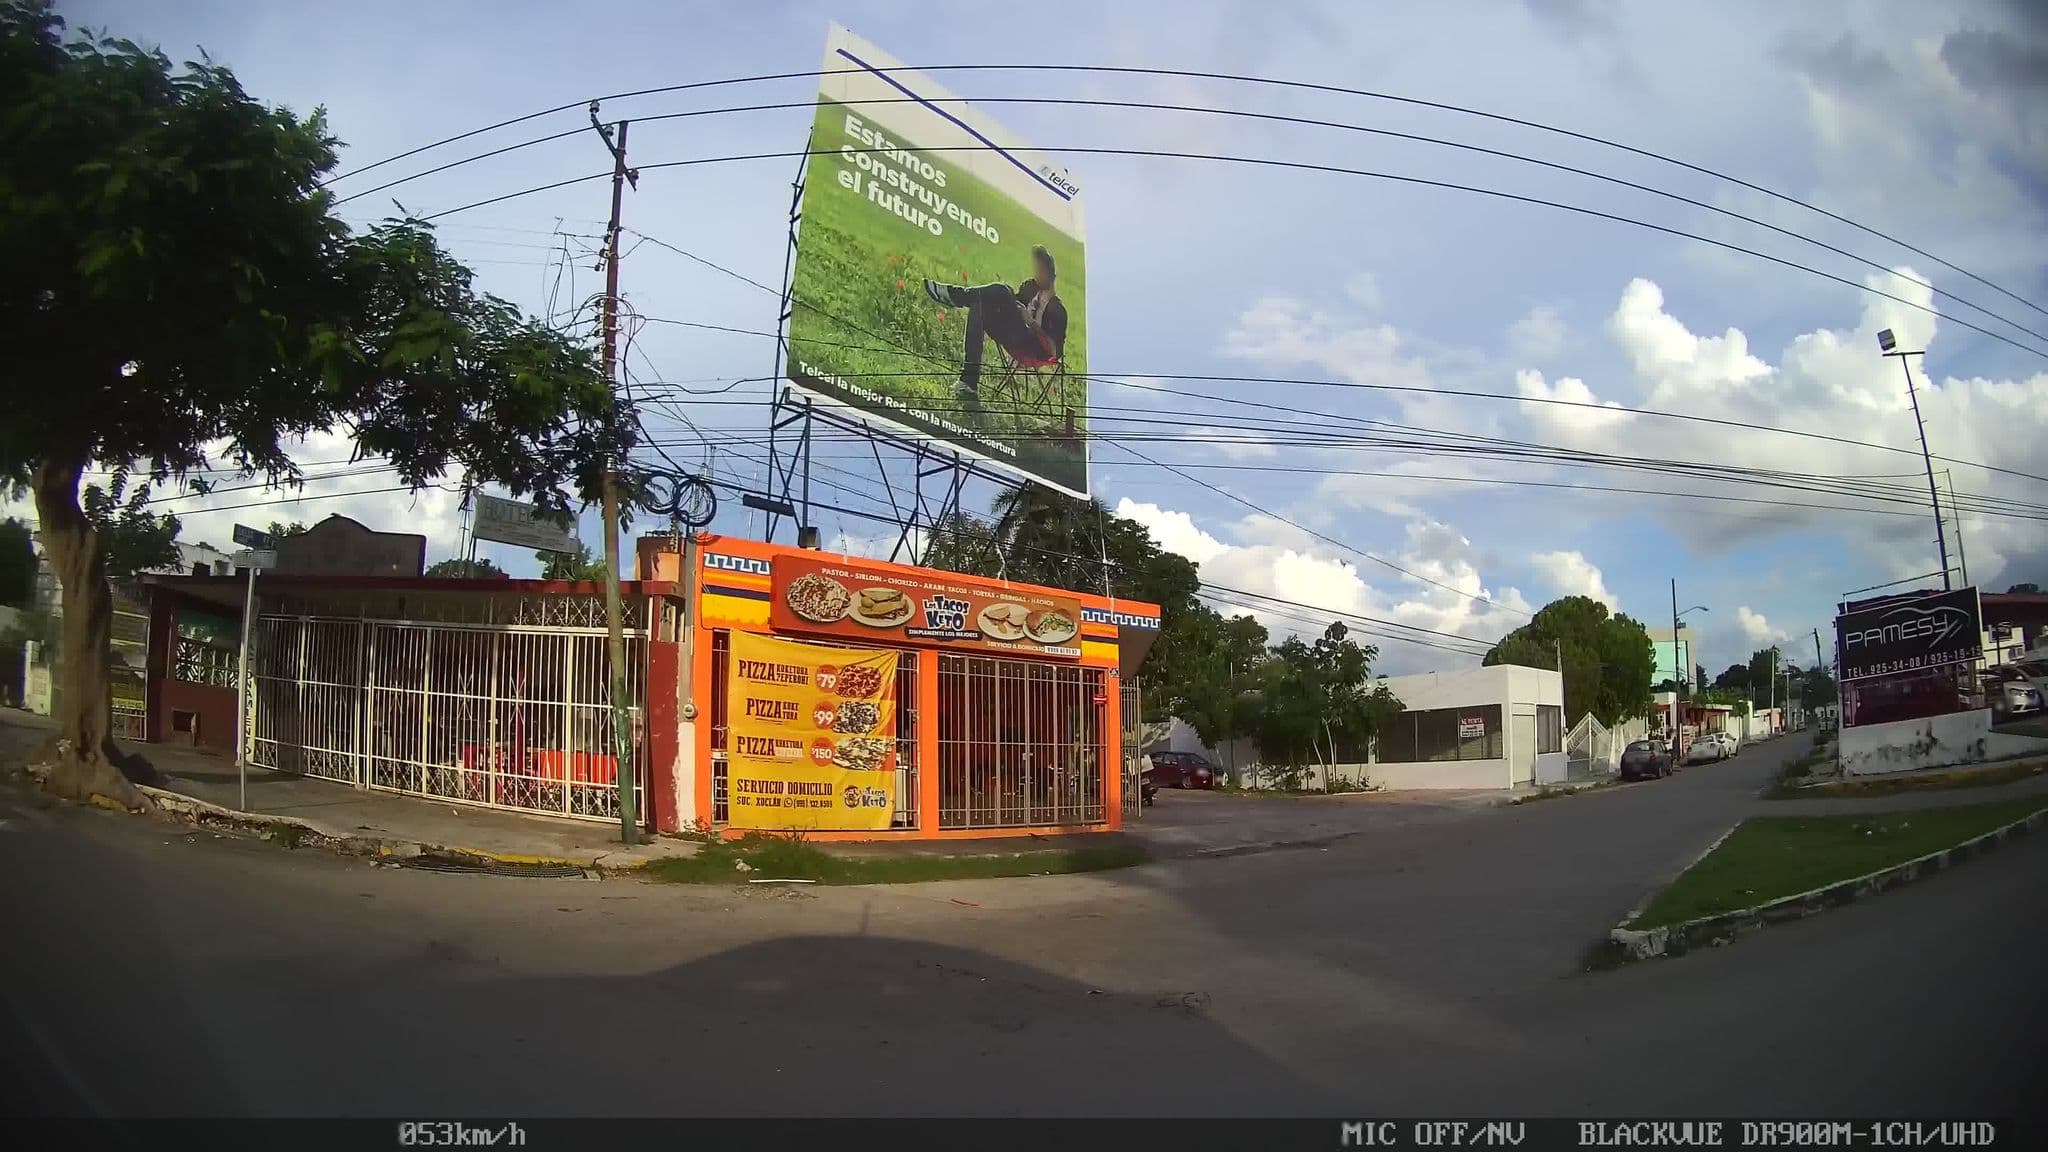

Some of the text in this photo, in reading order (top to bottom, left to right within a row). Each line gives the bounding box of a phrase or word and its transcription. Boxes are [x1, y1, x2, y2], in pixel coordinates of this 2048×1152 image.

[844, 114, 946, 188] Estamos
[840, 144, 1000, 244] construyendo
[1048, 171, 1080, 197] telcel
[837, 169, 943, 236] el futuro
[799, 362, 1017, 458] Telcel la mejor Red con la mayor Cobertura
[821, 567, 849, 578] PASTOR
[855, 573, 882, 582] SIRLOIN
[887, 578, 919, 588] CHORIZO
[923, 582, 945, 592] ARABE
[948, 586, 968, 595] TACOS
[972, 589, 996, 598] TORTAS
[1031, 597, 1055, 606] NACHOS
[934, 595, 970, 614] TACOS
[926, 611, 966, 631] KETO
[1845, 614, 1950, 650] PAMESY
[908, 629, 979, 639] SIMPLEMENTE LOS MEJORES
[986, 640, 1012, 649] SERVICIO
[738, 659, 775, 682] PIZZA
[1847, 667, 1868, 679] TEL.
[745, 697, 782, 719] PIZZA
[813, 711, 835, 725] $99
[736, 735, 775, 757] PIZZA
[811, 747, 833, 760] $150
[736, 779, 833, 796] SERVICIO DOMICILIO
[736, 796, 753, 807] SUC.
